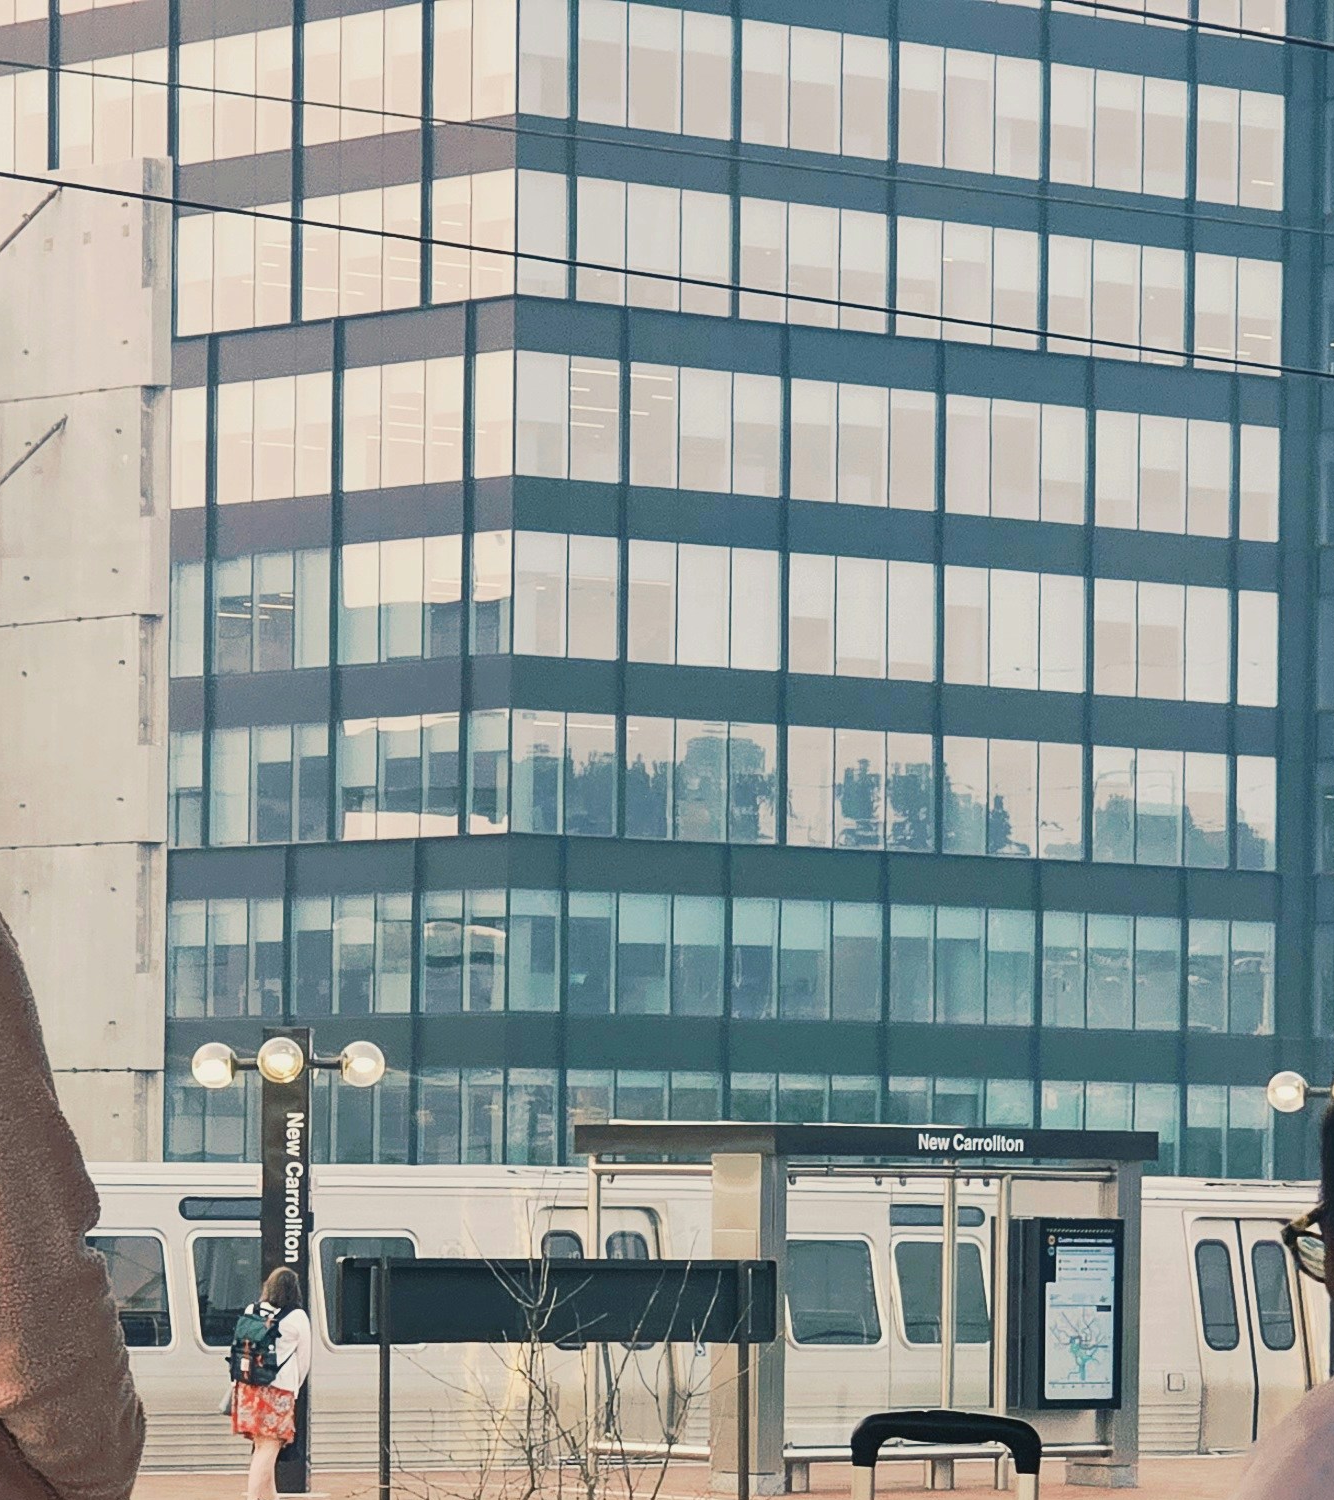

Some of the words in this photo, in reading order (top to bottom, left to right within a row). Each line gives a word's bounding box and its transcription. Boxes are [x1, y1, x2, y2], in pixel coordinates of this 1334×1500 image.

[285, 1112, 305, 1157] New
[918, 1133, 951, 1151] New
[953, 1133, 1024, 1152] Carrollton
[284, 1161, 304, 1263] Carrollton
